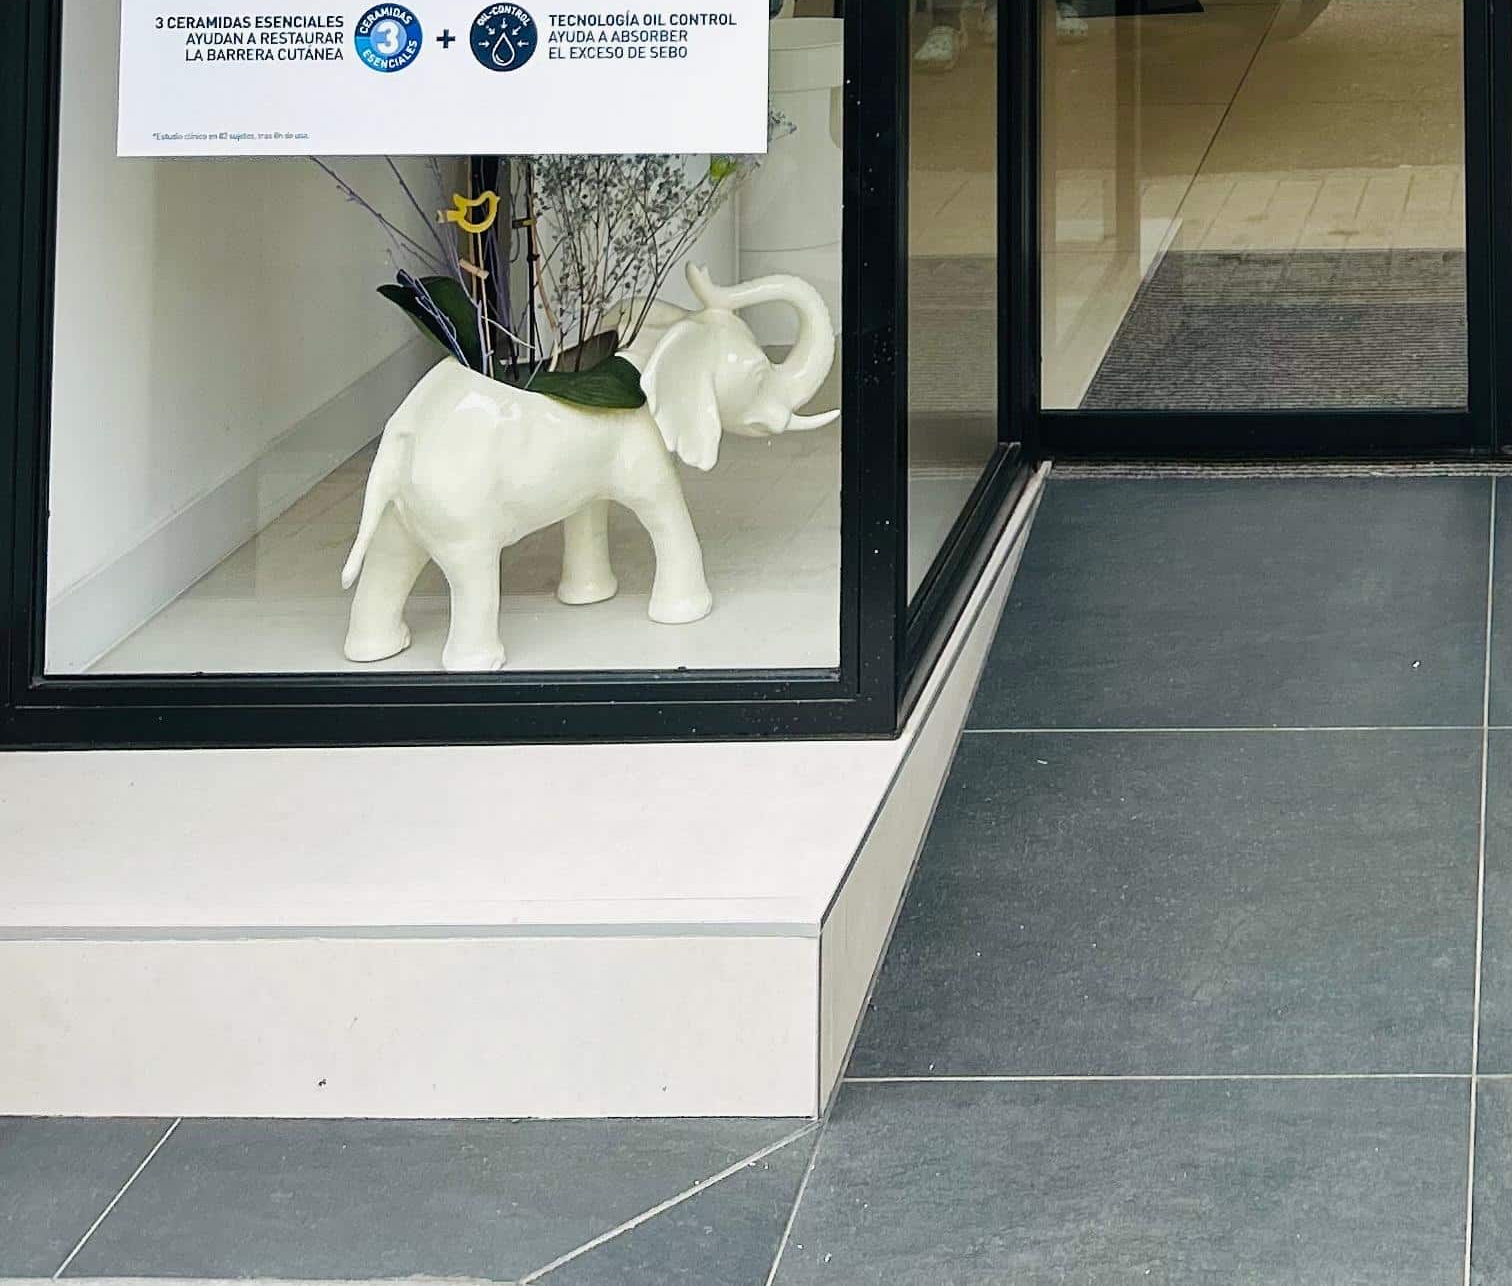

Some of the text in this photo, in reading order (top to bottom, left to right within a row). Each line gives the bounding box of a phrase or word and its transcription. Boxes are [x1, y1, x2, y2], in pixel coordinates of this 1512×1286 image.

[155, 15, 344, 29] 3 CERAMIDAS ESENCIALES
[360, 7, 412, 34] CERAMIDAS
[476, 5, 531, 27] OIL-CONTROL
[549, 10, 737, 27] TECNOLOGÍA OIL CONTROL
[186, 31, 344, 45] AYUDAN A RESTAURAR
[377, 21, 399, 54] 3
[548, 29, 688, 43] AYUDA A ABSORBER
[186, 44, 344, 61] LA BARRERA CUTÁNEA
[363, 40, 418, 69] ESENCIALES
[549, 46, 688, 59] EL EXCESO DE SEBO
